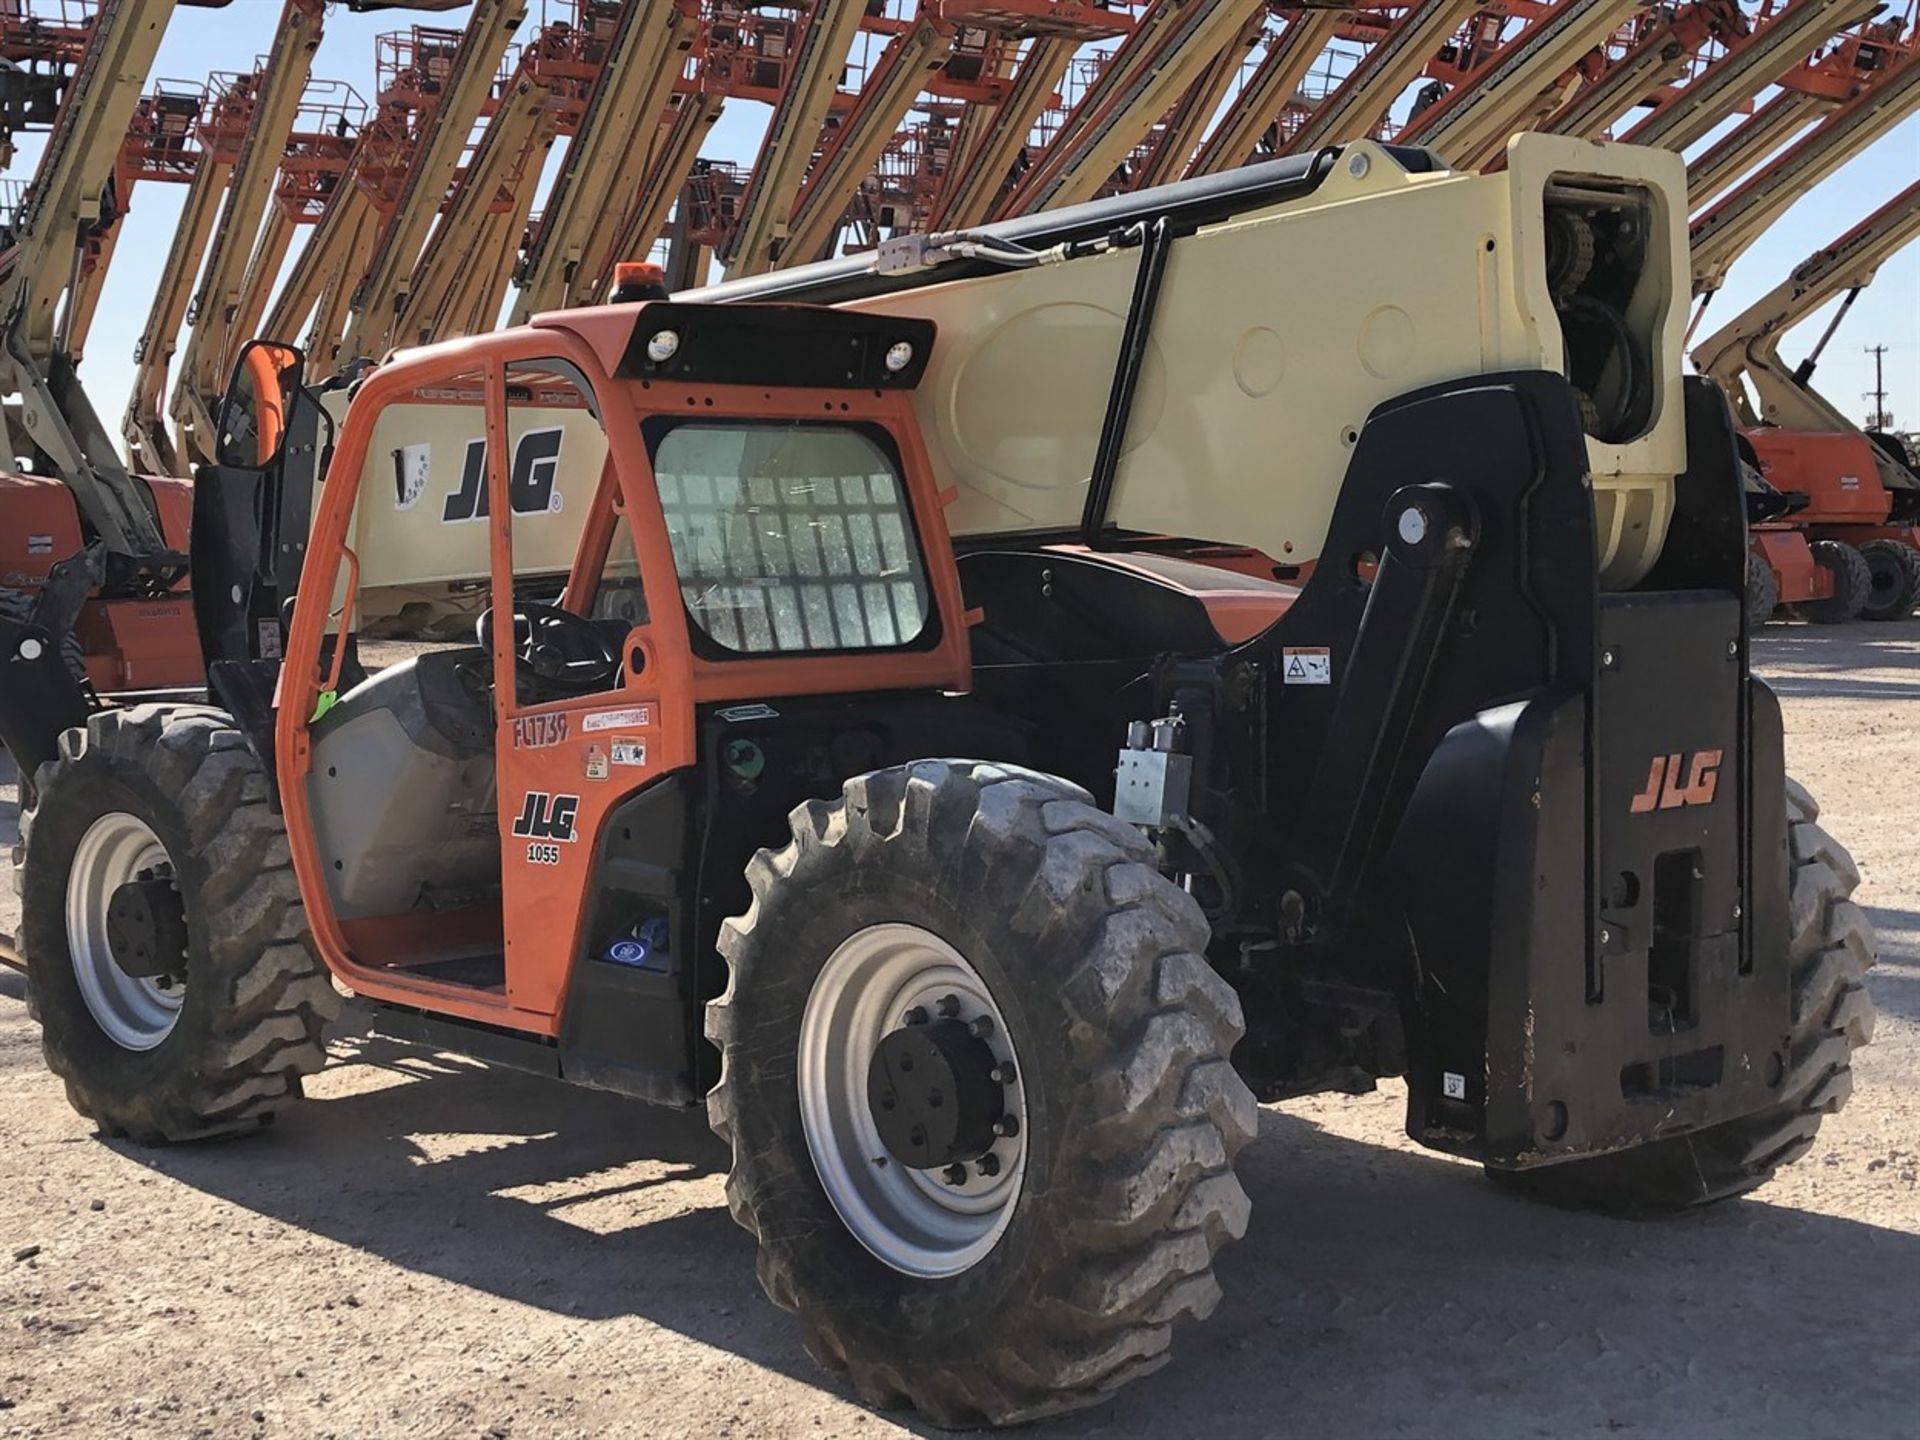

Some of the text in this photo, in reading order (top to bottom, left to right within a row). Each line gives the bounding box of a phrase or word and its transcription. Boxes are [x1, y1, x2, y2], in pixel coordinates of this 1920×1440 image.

[1630, 749, 1723, 812] JLG
[513, 792, 578, 840] JLG
[528, 845, 558, 863] 1055
